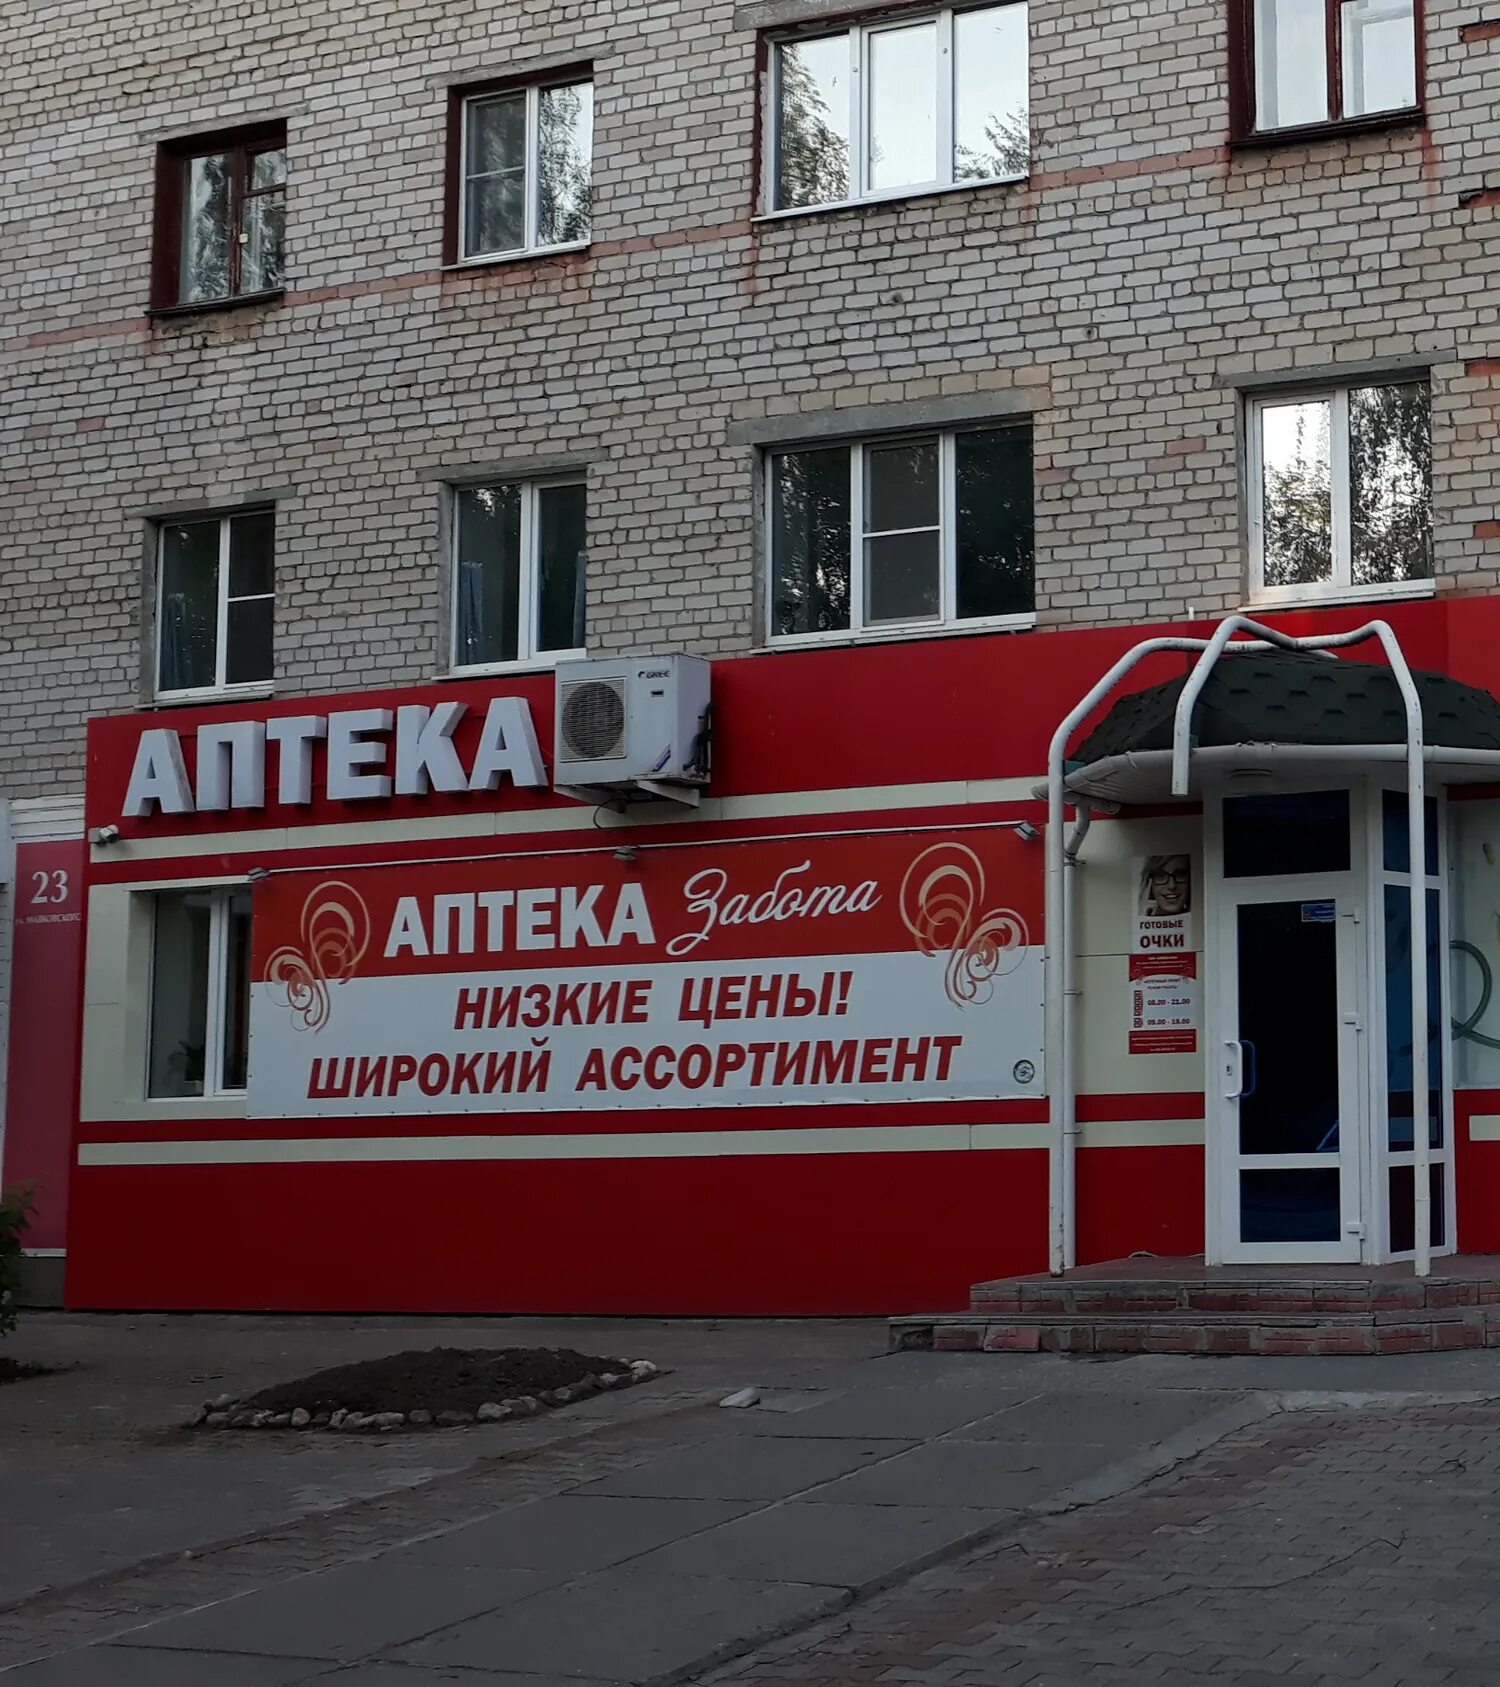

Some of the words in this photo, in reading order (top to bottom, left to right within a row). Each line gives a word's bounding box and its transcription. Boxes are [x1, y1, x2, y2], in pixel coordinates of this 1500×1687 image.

[121, 696, 549, 818] АПТЕКА
[31, 869, 69, 904] 23
[383, 882, 656, 958] АПТЕКА
[665, 860, 883, 956] Забота
[1140, 920, 1184, 930] ГОТОВЫЕ
[1140, 934, 1185, 949] ОЧКИ
[454, 979, 653, 1030] НИЗКИЕ
[677, 970, 853, 1029] ЦЕНЫ!
[307, 1036, 551, 1099] ШИРОКИЙ
[574, 1035, 963, 1092] АССОРТИМЕНТ
